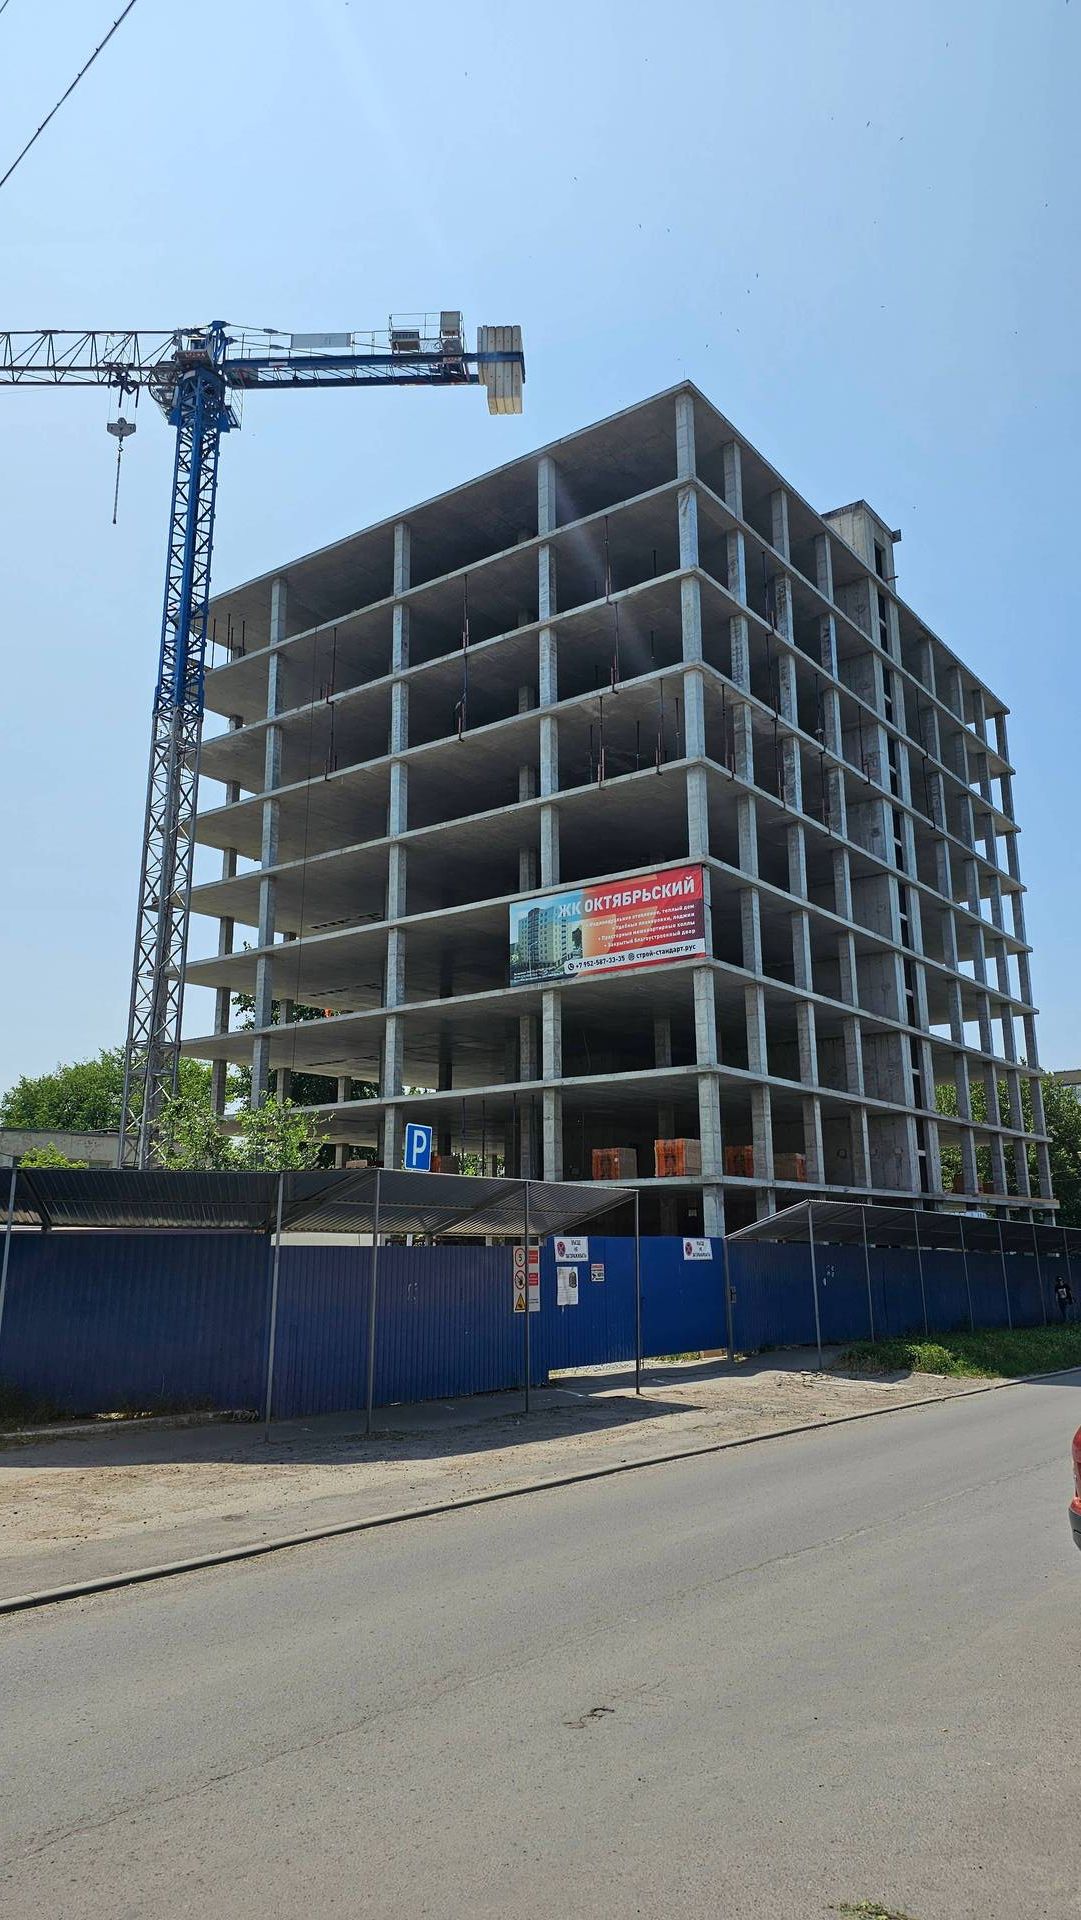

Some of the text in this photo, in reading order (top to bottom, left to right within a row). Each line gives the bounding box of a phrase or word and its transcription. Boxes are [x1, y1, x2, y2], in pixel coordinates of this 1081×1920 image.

[557, 876, 695, 918] ЖК ОКТЯБРЬСКИЙ
[677, 920, 696, 928] холлы
[636, 944, 697, 959] строй-стандарт.рус
[575, 962, 583, 970] +7
[412, 1129, 427, 1166] P
